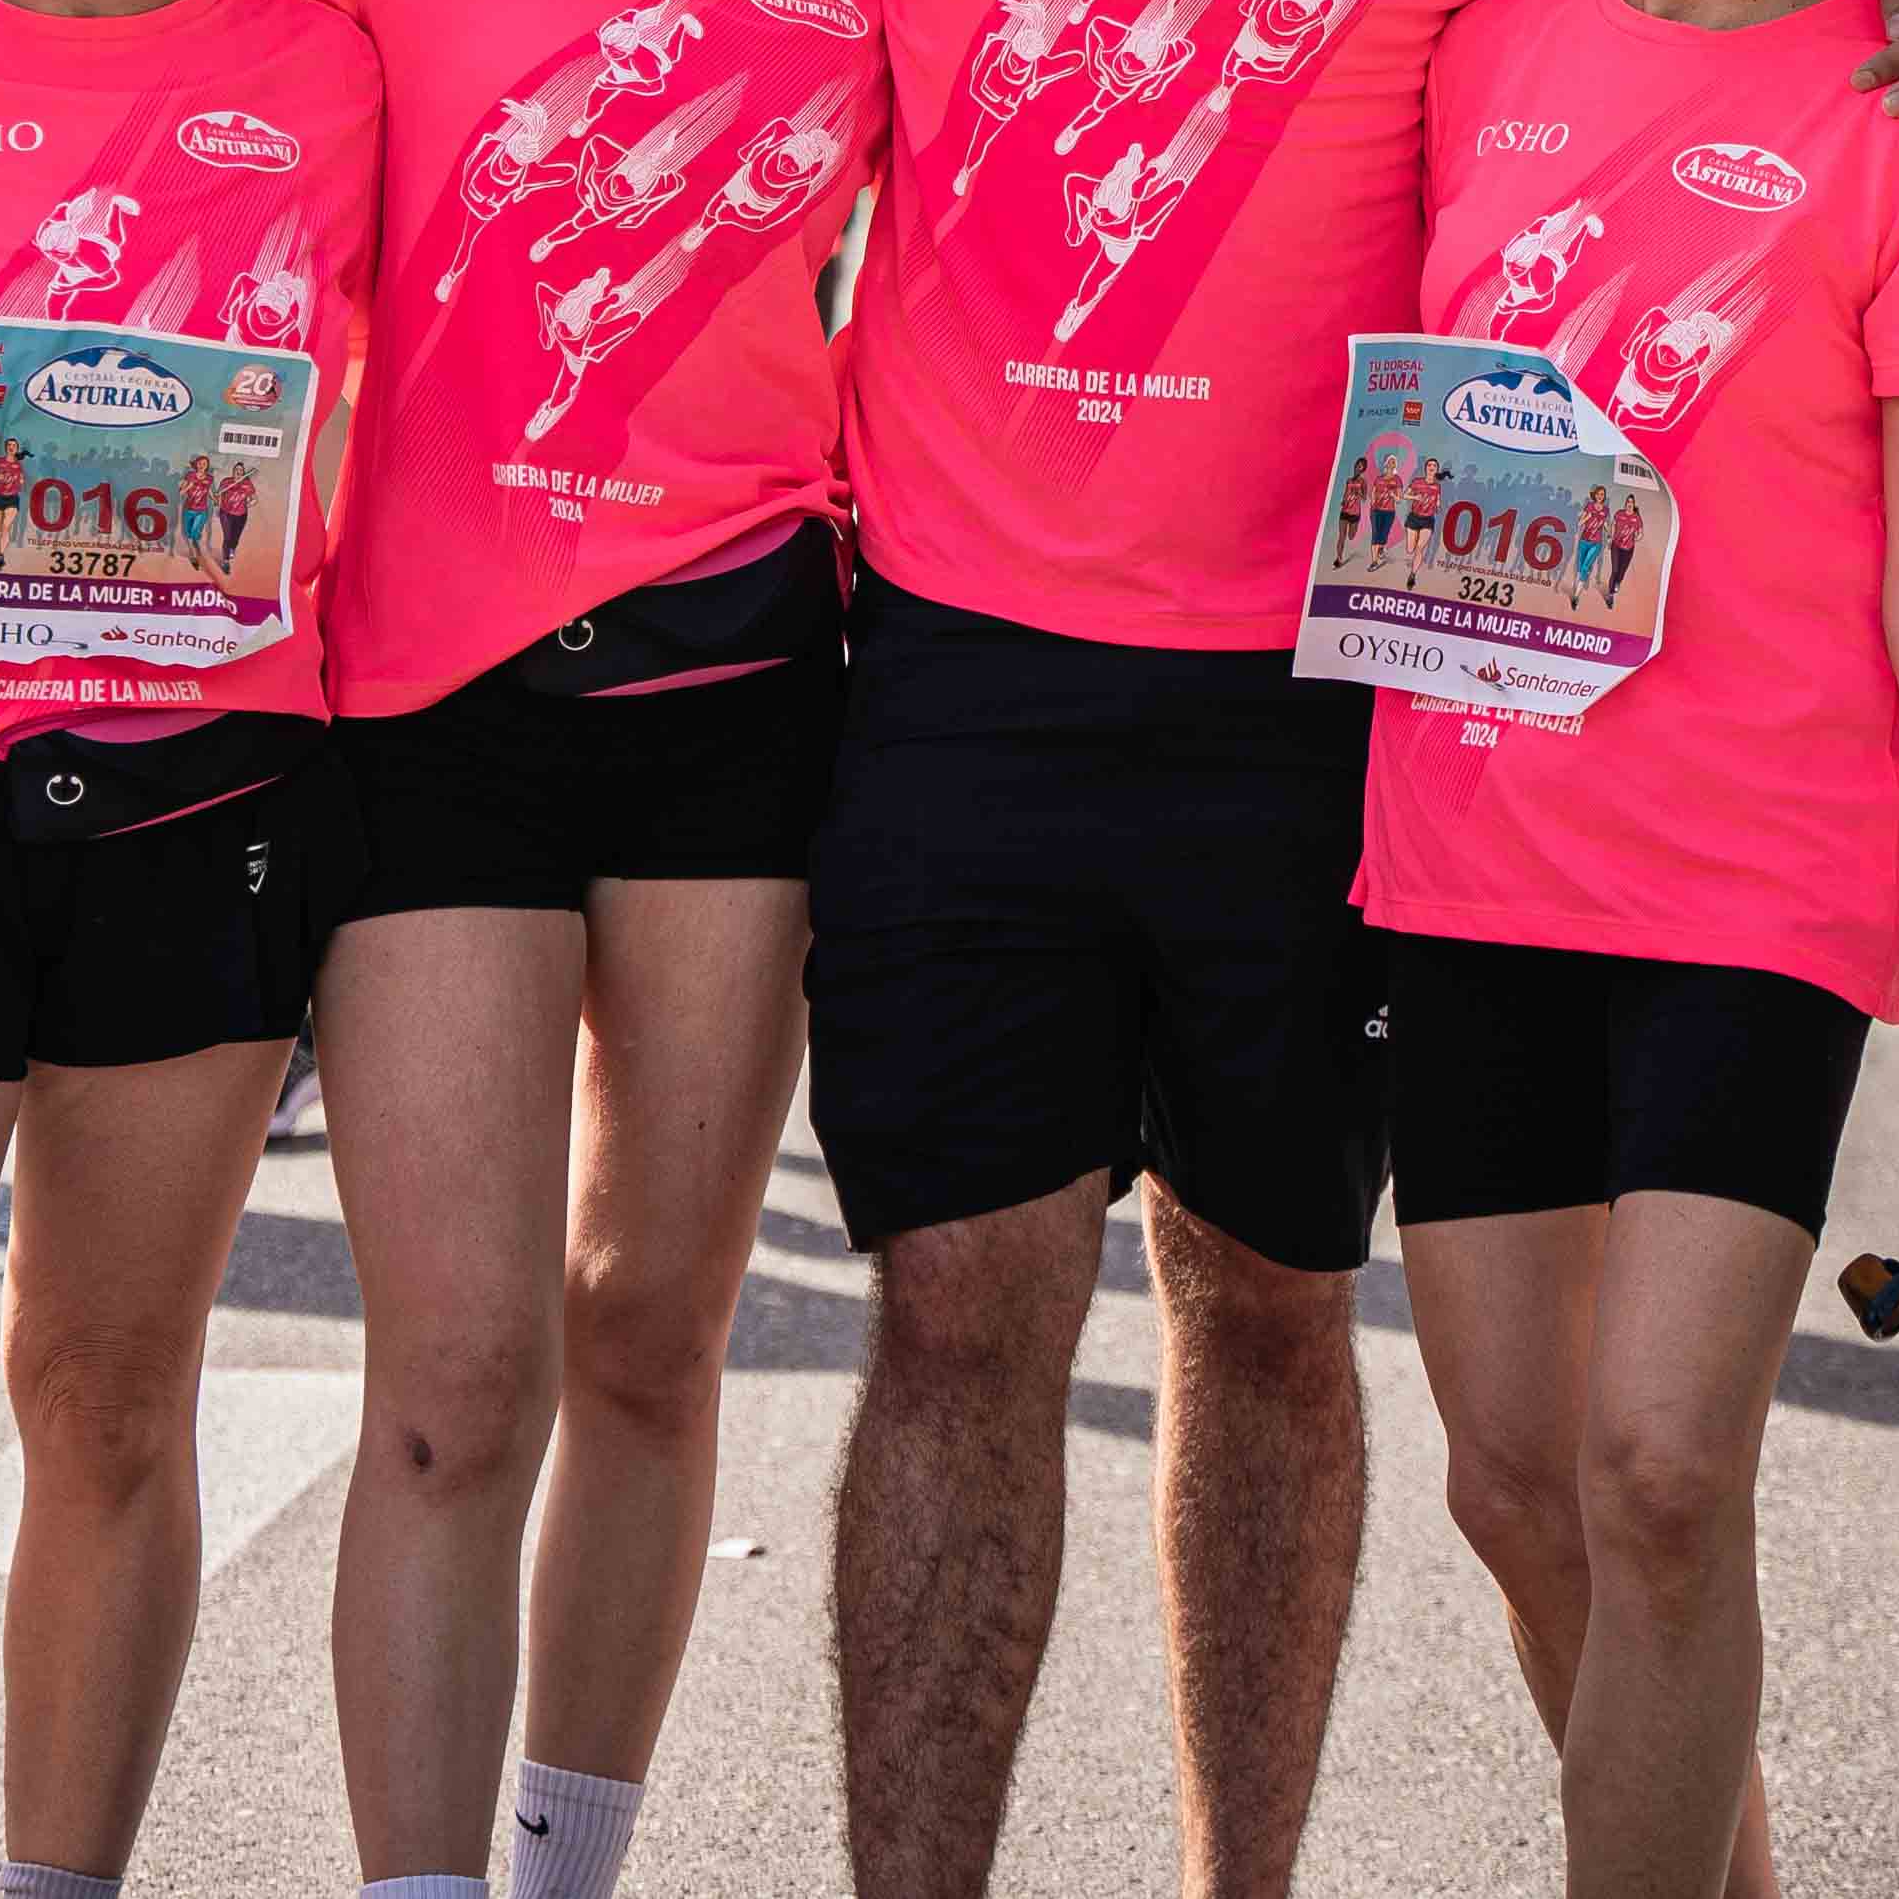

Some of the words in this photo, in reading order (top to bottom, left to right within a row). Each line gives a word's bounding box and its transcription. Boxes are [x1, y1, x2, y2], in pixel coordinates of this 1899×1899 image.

[189, 127, 292, 164] ASTURIANA
[1680, 155, 1795, 203] ASTURIANA
[36, 372, 180, 413] ASTURIANA
[235, 371, 276, 396] 20
[1005, 361, 1079, 393] CARRERA
[1085, 370, 1110, 395] DE
[1114, 372, 1137, 397] LA
[1143, 374, 1211, 401] MUJER
[1367, 372, 1420, 393] SUMA
[1076, 398, 1123, 424] 2024
[551, 470, 572, 495] DE
[575, 473, 597, 499] LA
[600, 479, 664, 507] MUJER
[29, 478, 170, 541] 016
[549, 497, 584, 524] 2024
[1442, 500, 1567, 572] 016
[50, 551, 136, 578] 33787
[29, 583, 53, 602] DE
[59, 584, 82, 604] LA
[89, 585, 153, 607] MUJER
[1458, 575, 1515, 608] 3243
[1348, 591, 1426, 622] CARRERA
[1431, 605, 1452, 625] DE
[1454, 608, 1472, 630] LA
[1476, 611, 1532, 641] MUJER
[1544, 626, 1612, 656] MADRID
[1339, 633, 1444, 673] OYSHO
[80, 679, 106, 703] DE
[111, 679, 134, 702] LA
[137, 680, 203, 702] MUJER
[1504, 666, 1600, 698] Santander
[1459, 721, 1499, 749] 2024
